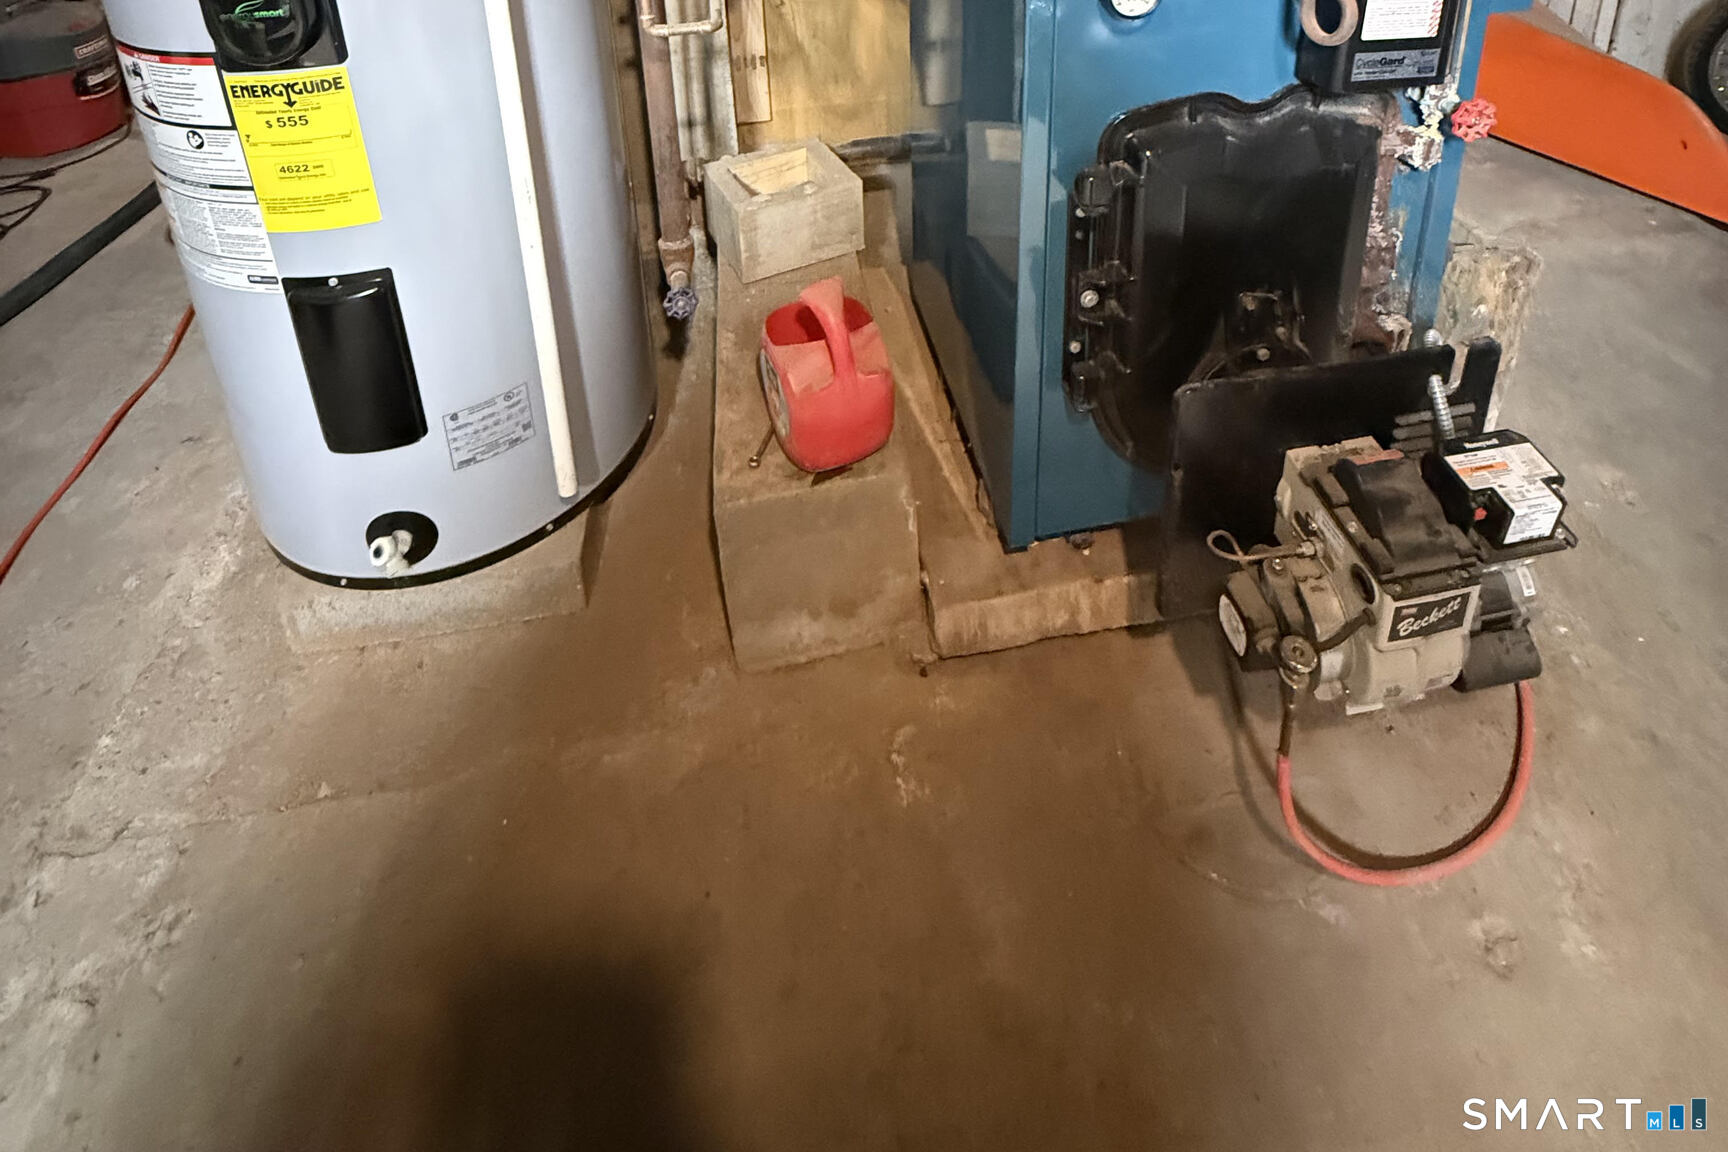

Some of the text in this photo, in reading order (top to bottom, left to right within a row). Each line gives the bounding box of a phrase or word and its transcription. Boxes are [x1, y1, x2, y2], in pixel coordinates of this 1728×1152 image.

[265, 114, 310, 129] $ 555
[279, 164, 310, 174] 4622
[1397, 596, 1461, 637] Beckett
